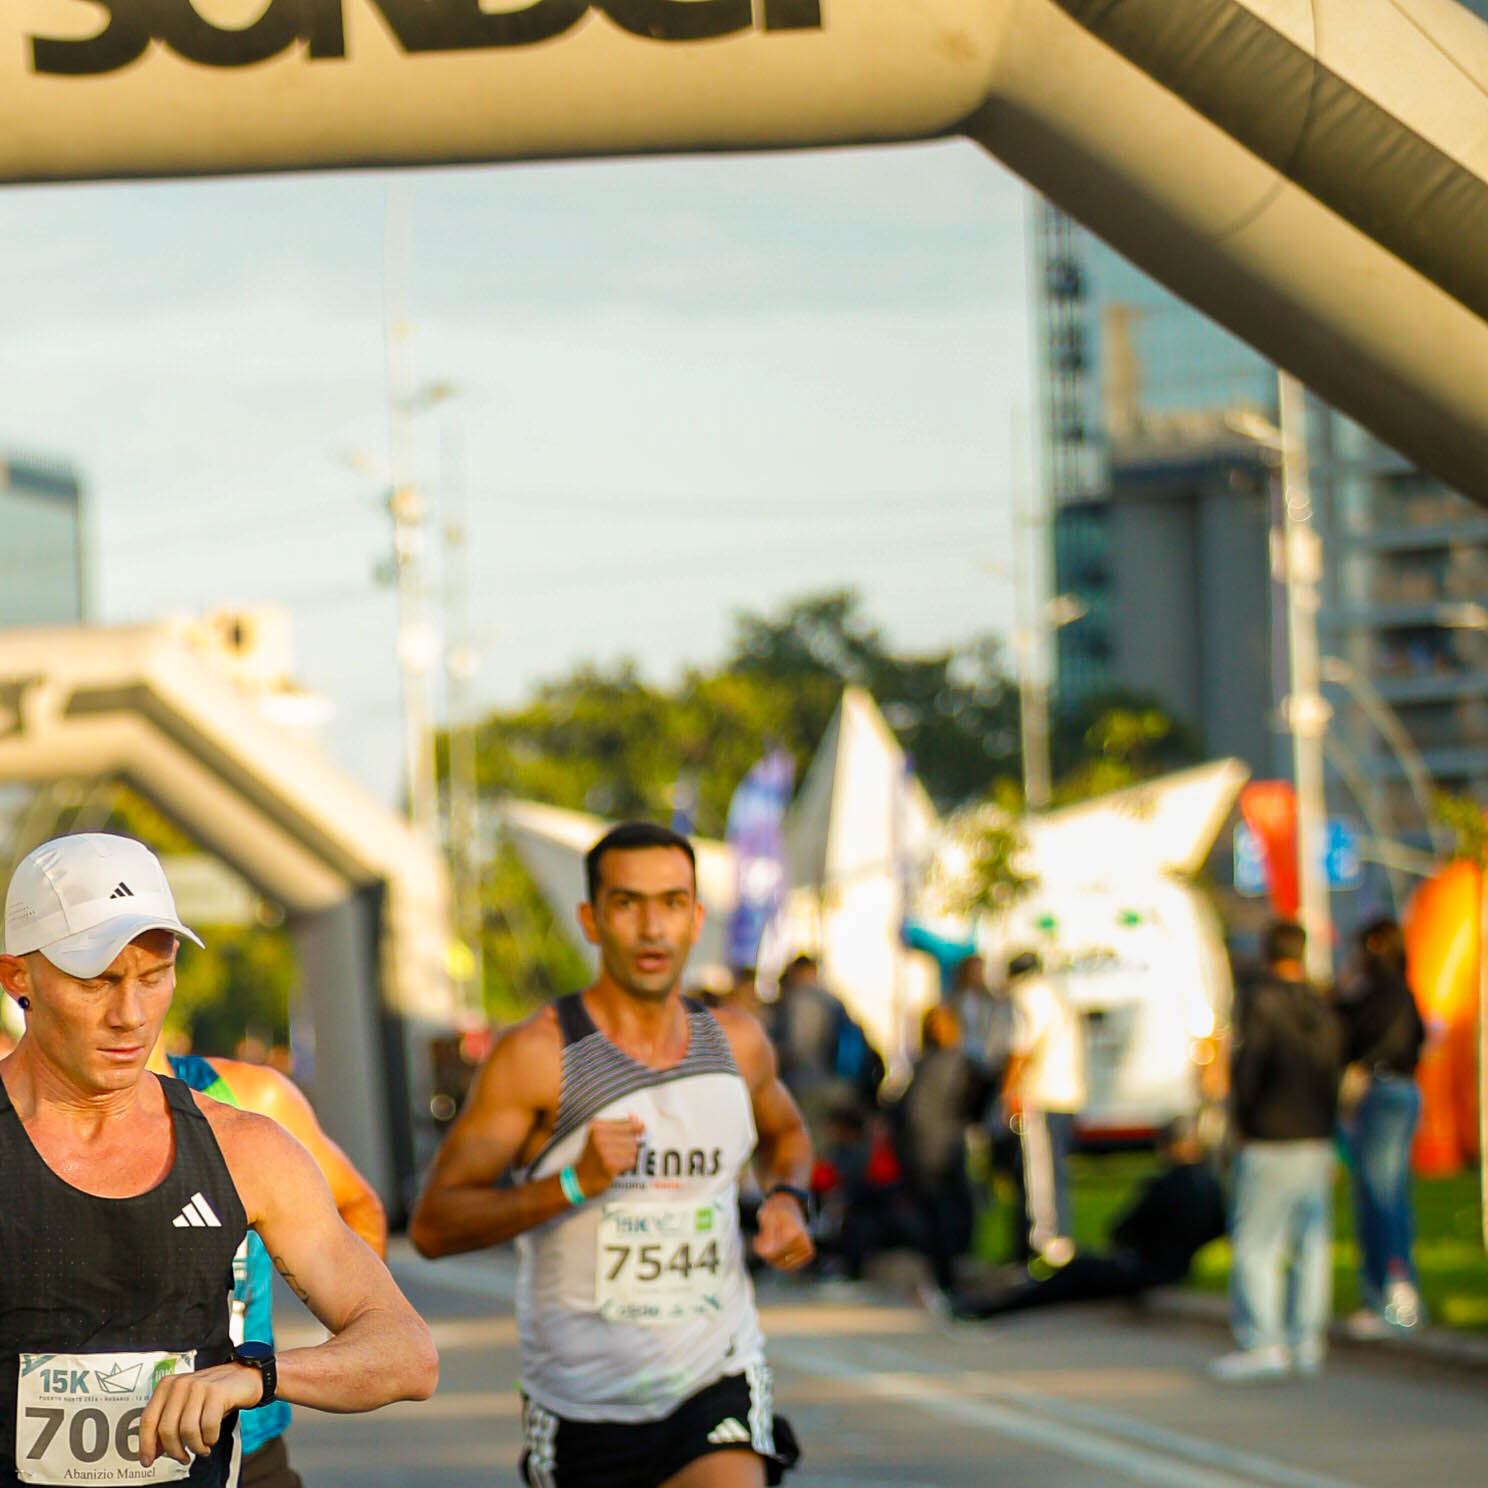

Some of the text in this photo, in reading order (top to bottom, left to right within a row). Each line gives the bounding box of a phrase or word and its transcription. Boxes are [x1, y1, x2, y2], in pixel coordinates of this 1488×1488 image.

[618, 1141, 720, 1176] TENAS
[605, 1241, 720, 1280] 7544
[39, 1369, 90, 1394] 15K
[25, 1407, 143, 1462] 706
[63, 1467, 156, 1480] Abanizio Manuel
